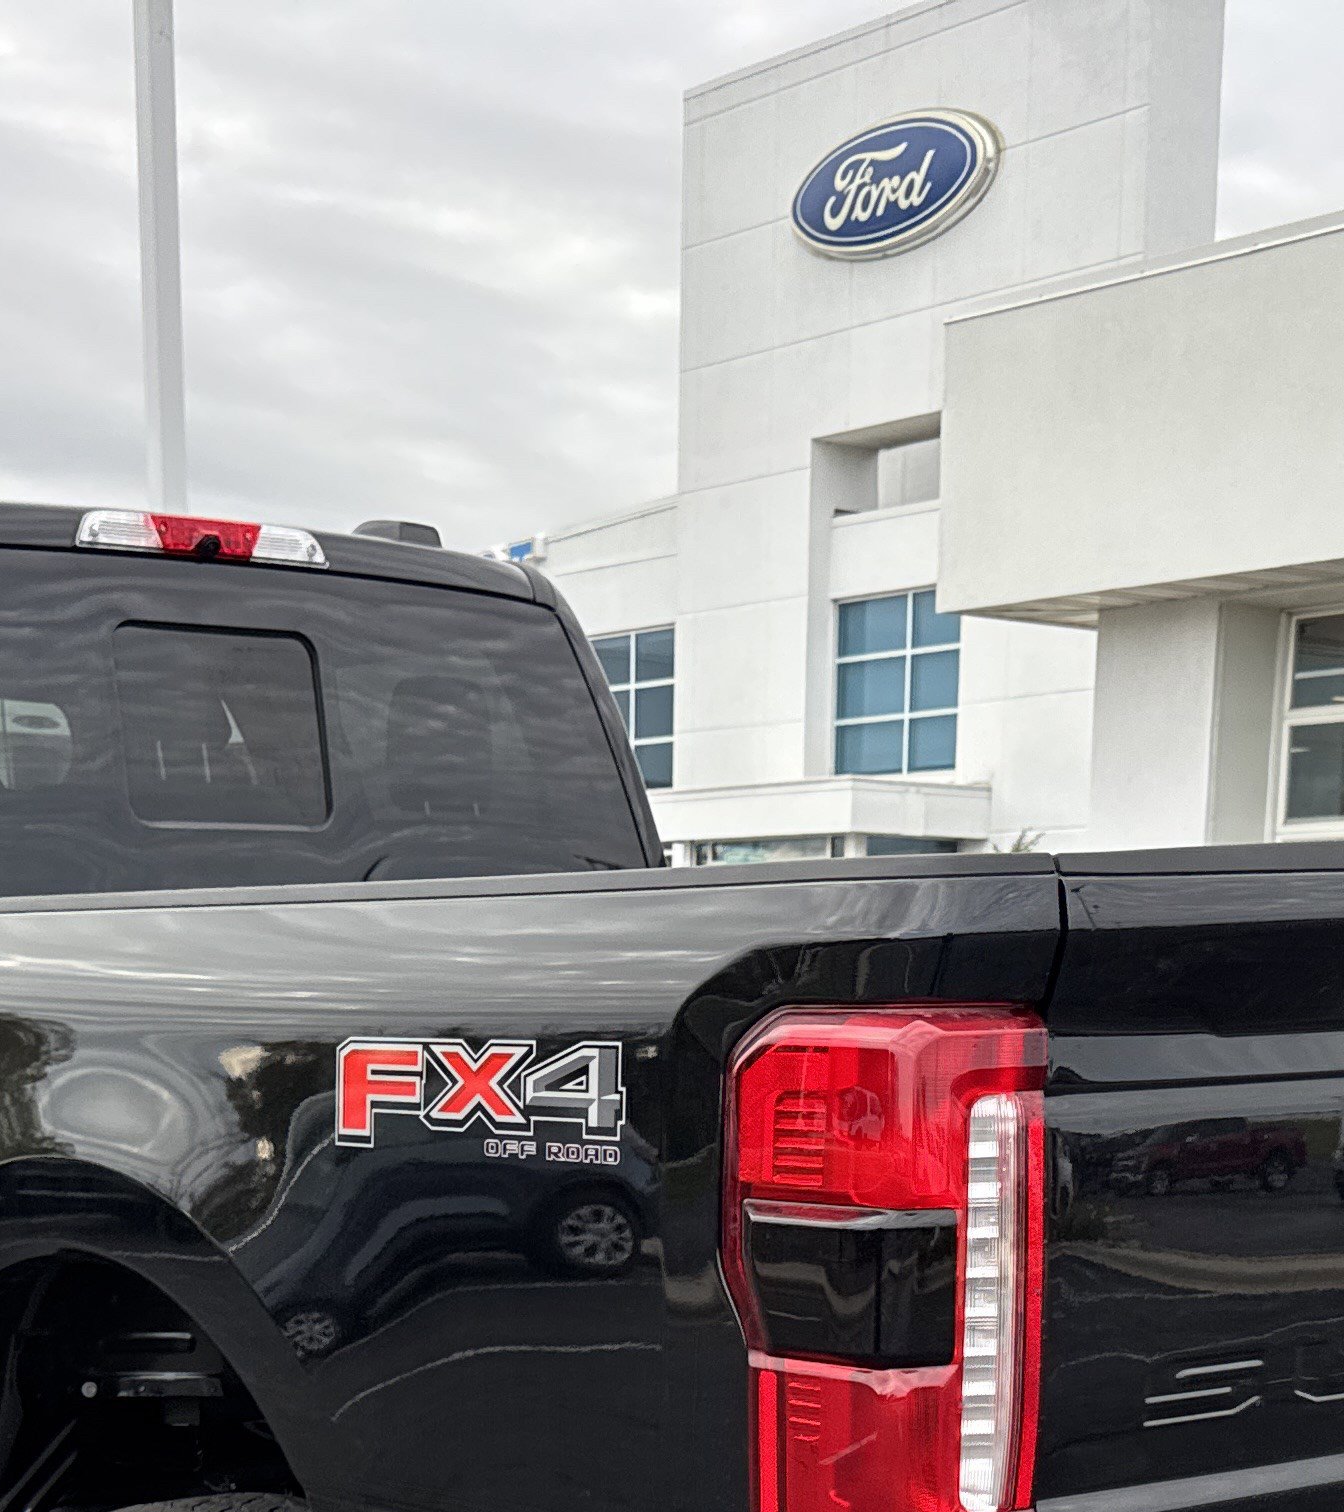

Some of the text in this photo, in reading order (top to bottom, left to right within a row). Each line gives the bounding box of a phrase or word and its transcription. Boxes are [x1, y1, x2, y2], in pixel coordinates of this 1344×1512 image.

[823, 141, 936, 232] Ford
[334, 1036, 627, 1149] FX4
[483, 1138, 621, 1165] OFF ROAD
